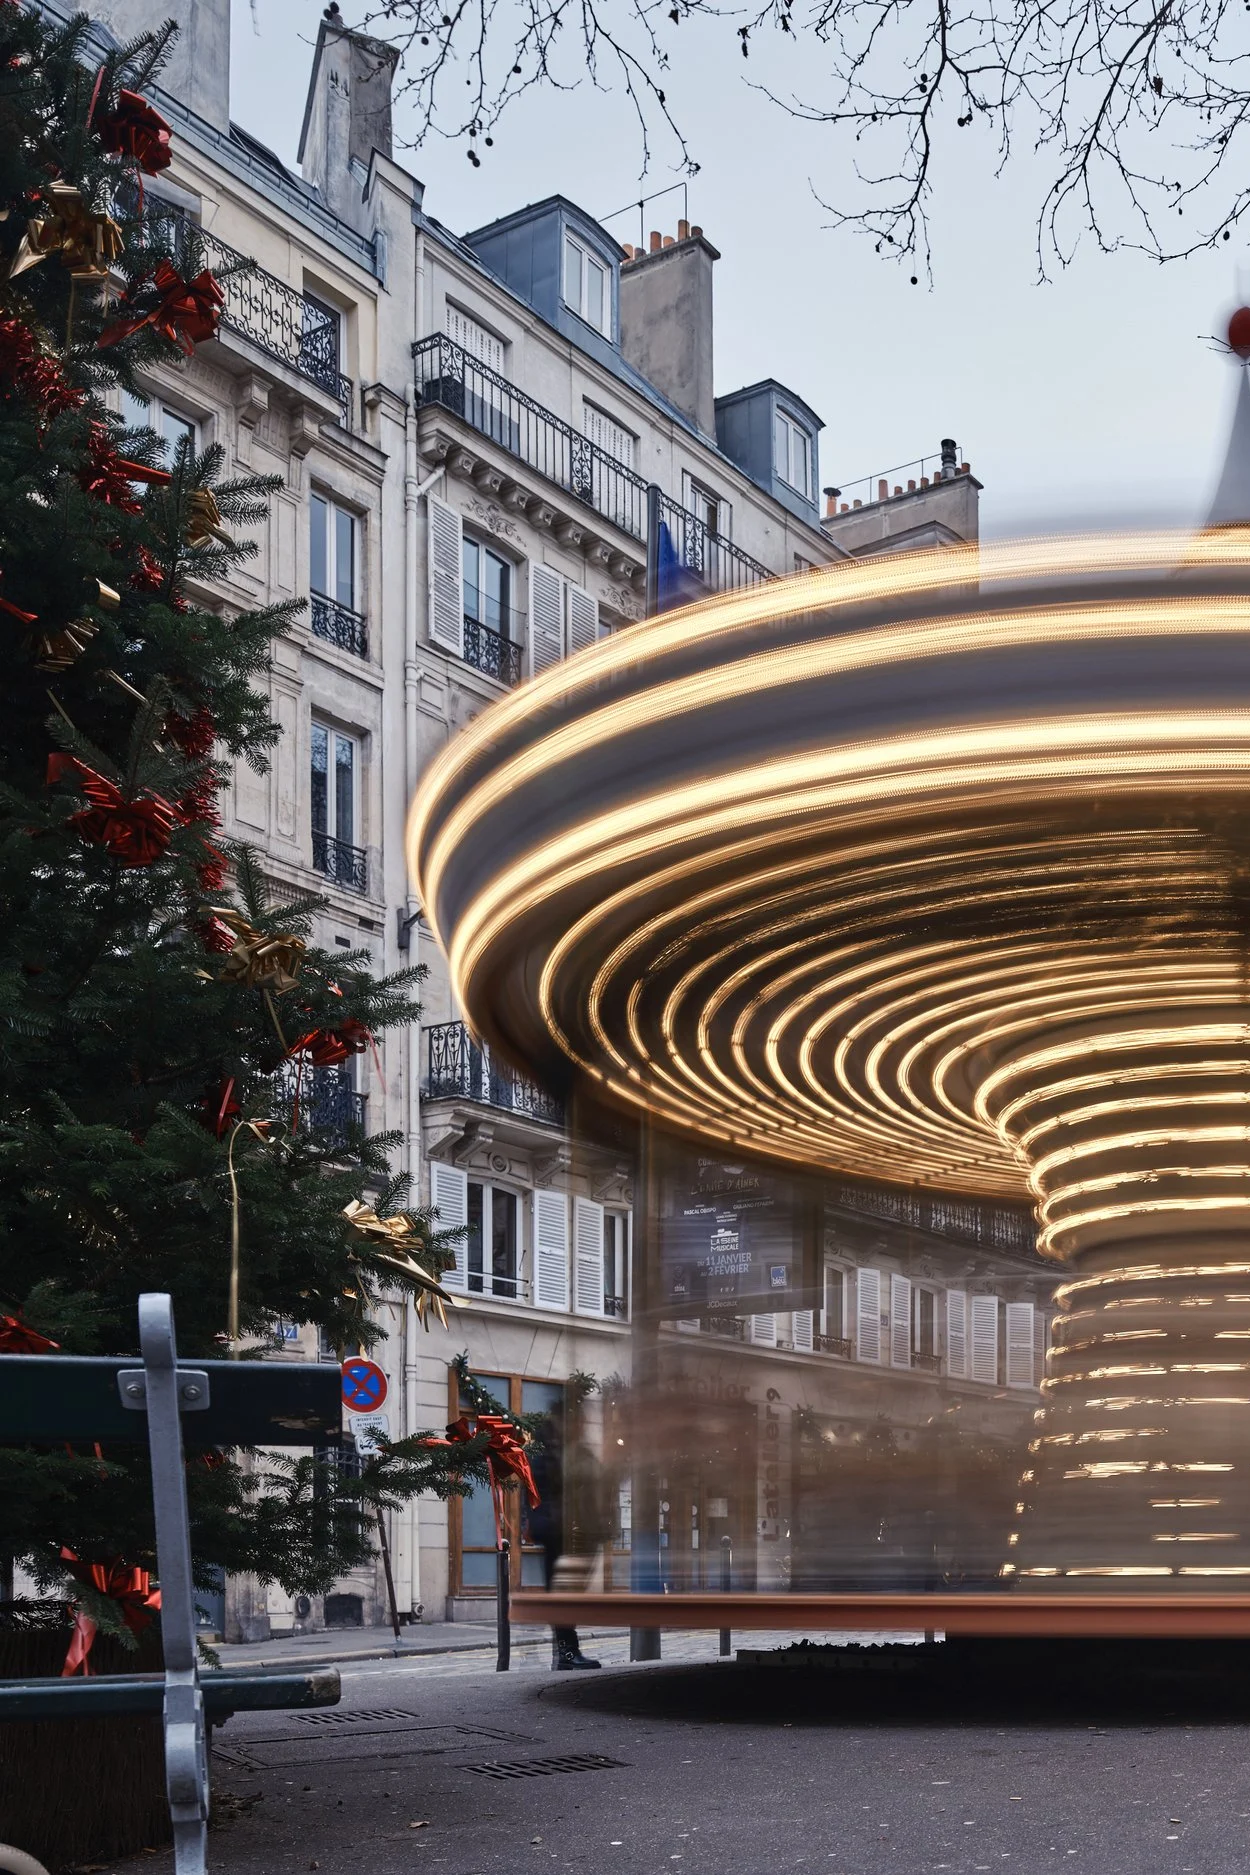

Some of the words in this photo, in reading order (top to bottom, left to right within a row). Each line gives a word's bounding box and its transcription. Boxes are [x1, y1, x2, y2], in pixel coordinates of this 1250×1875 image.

[684, 1208, 699, 1216] PASCAL
[720, 1236, 739, 1245] SEINE
[710, 1243, 739, 1252] MUSICALE
[706, 1255, 716, 1266] 11
[717, 1252, 752, 1265] JANVIER
[708, 1266, 714, 1276] 2
[706, 1300, 738, 1309] JCDecaux
